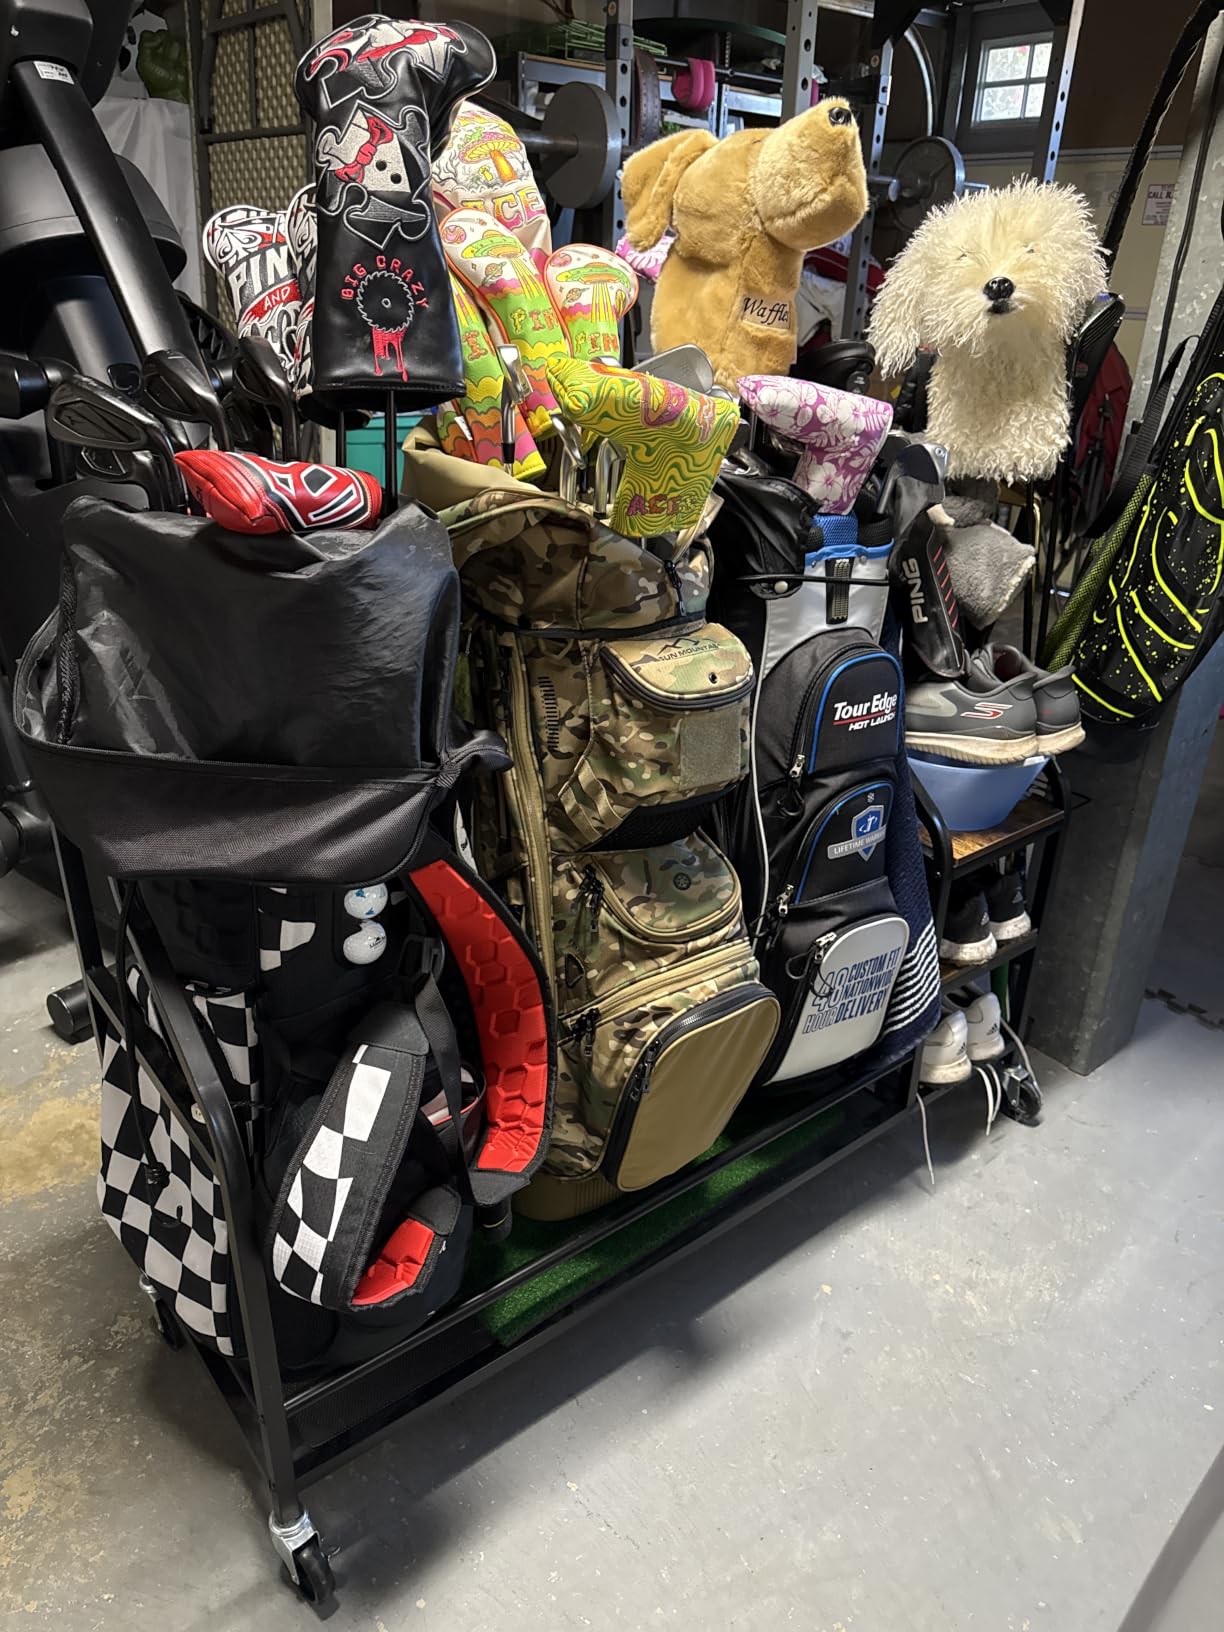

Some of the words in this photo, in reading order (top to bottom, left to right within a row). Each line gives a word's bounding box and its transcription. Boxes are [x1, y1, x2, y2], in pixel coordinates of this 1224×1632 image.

[461, 187, 546, 230] CE
[341, 264, 367, 300] BIG
[376, 255, 430, 309] CRAZY
[264, 286, 290, 311] AND
[902, 558, 928, 624] PING
[659, 653, 677, 661] SUN
[834, 701, 871, 720] Tour
[871, 691, 898, 713] Edge
[848, 720, 870, 731] HOT
[833, 839, 865, 855] LIFETIME
[848, 952, 888, 982] CUSTOM
[886, 946, 901, 970] FIT
[812, 967, 849, 1012] 48
[802, 1007, 837, 1034] HOUR
